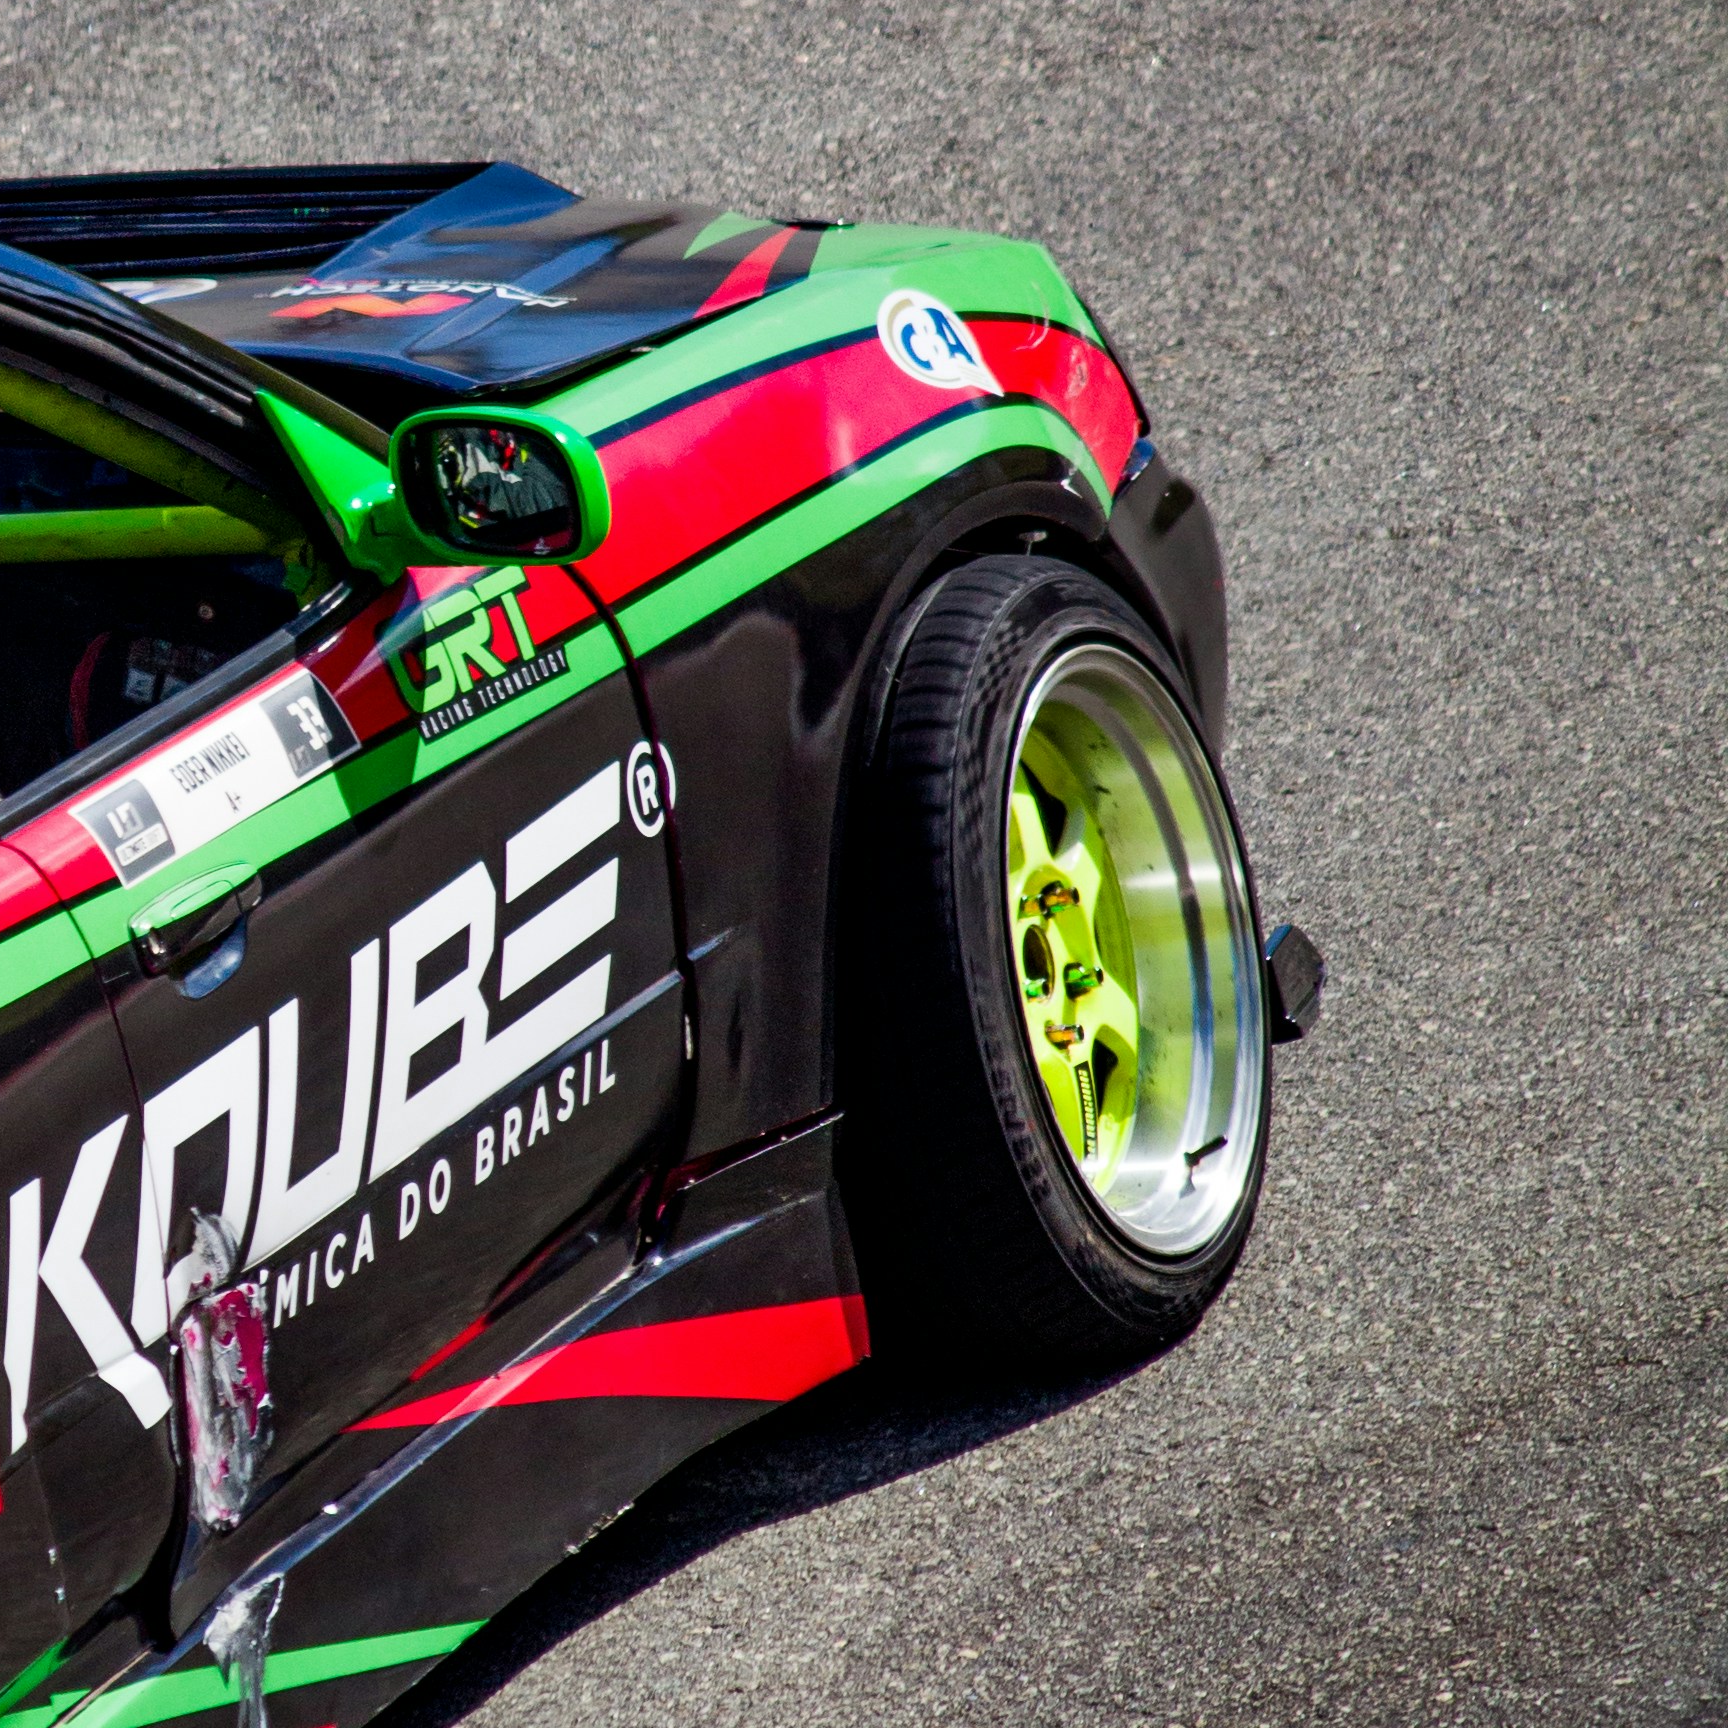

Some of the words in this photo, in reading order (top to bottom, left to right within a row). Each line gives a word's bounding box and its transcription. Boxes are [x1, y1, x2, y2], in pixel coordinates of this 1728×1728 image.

[286, 695, 333, 751] 33
[421, 698, 473, 738] RACING
[477, 650, 566, 708] TECHNOLOGY
[171, 742, 207, 794] EDER
[400, 1158, 452, 1233] DO
[475, 1039, 616, 1186] BRASIL
